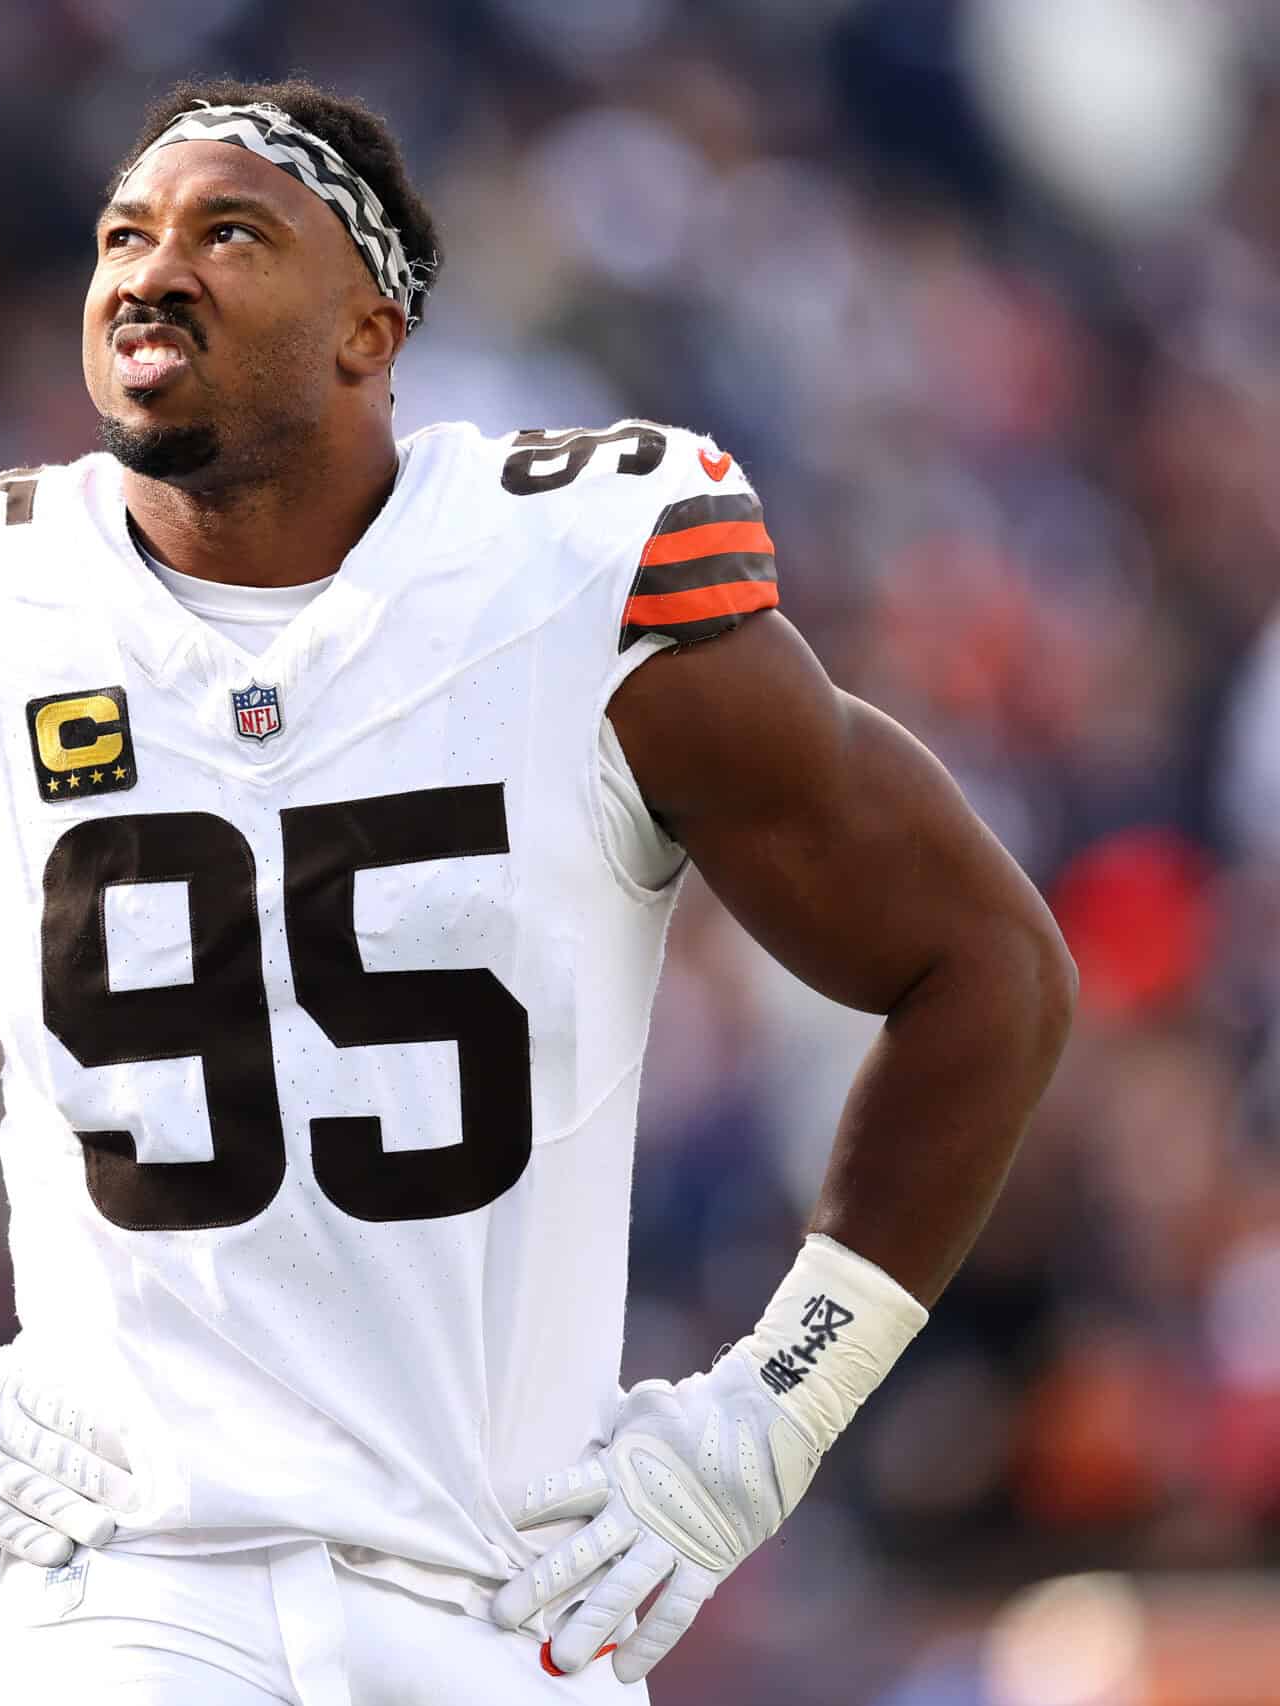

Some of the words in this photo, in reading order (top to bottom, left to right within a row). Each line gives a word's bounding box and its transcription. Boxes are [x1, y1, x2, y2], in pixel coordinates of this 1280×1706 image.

[501, 420, 671, 496] 9
[35, 695, 123, 773] C
[239, 708, 277, 735] NFL
[41, 782, 533, 1232] 95
